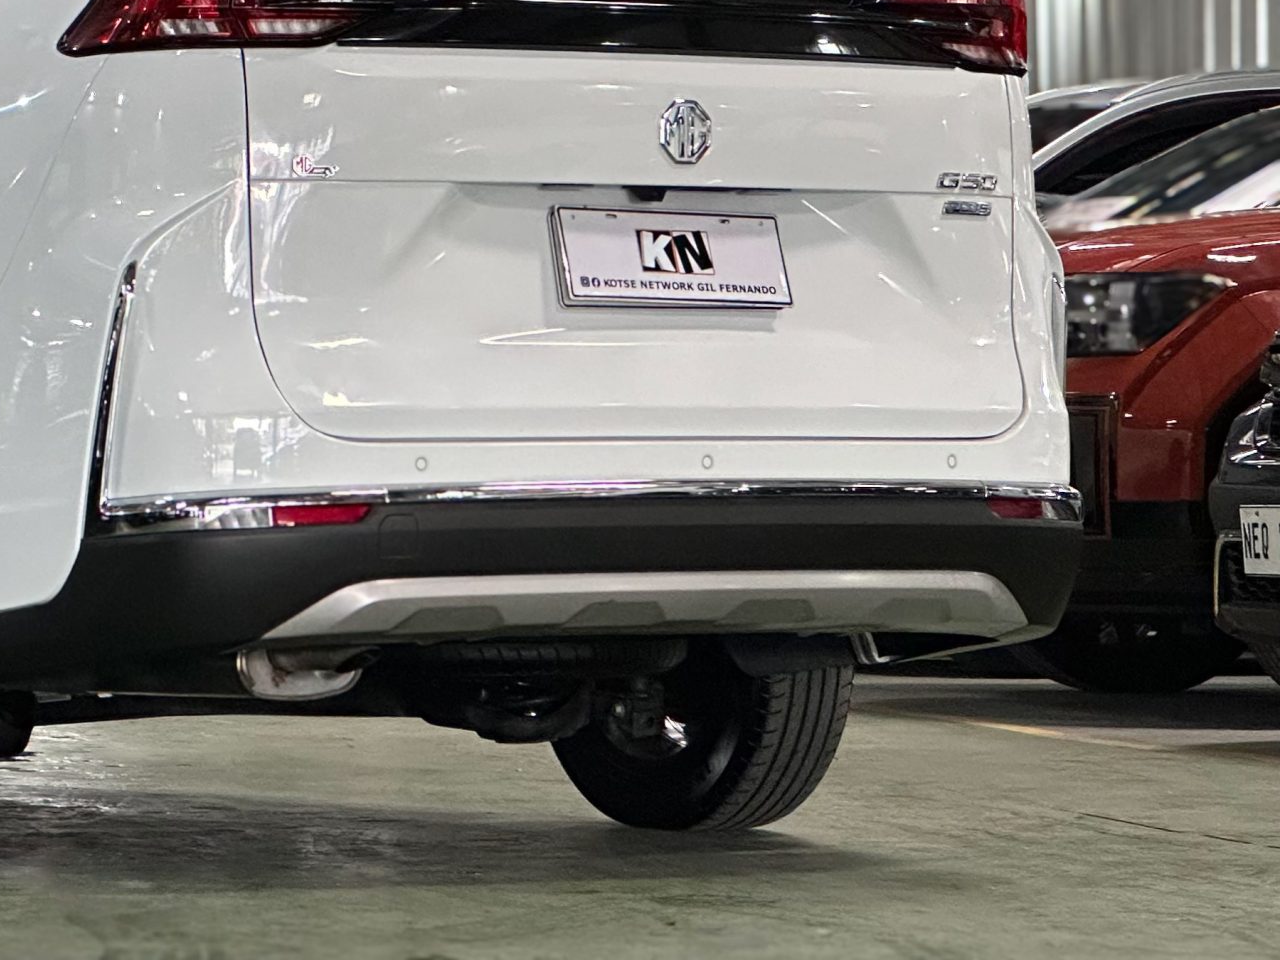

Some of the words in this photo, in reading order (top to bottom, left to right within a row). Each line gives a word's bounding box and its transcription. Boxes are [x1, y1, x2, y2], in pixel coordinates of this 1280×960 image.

[639, 230, 713, 274] KN
[603, 278, 637, 289] KOTSE
[640, 280, 694, 291] NETWORK
[697, 282, 717, 292] GIL
[719, 283, 777, 295] FERNANDO
[1242, 522, 1269, 560] NEQ
